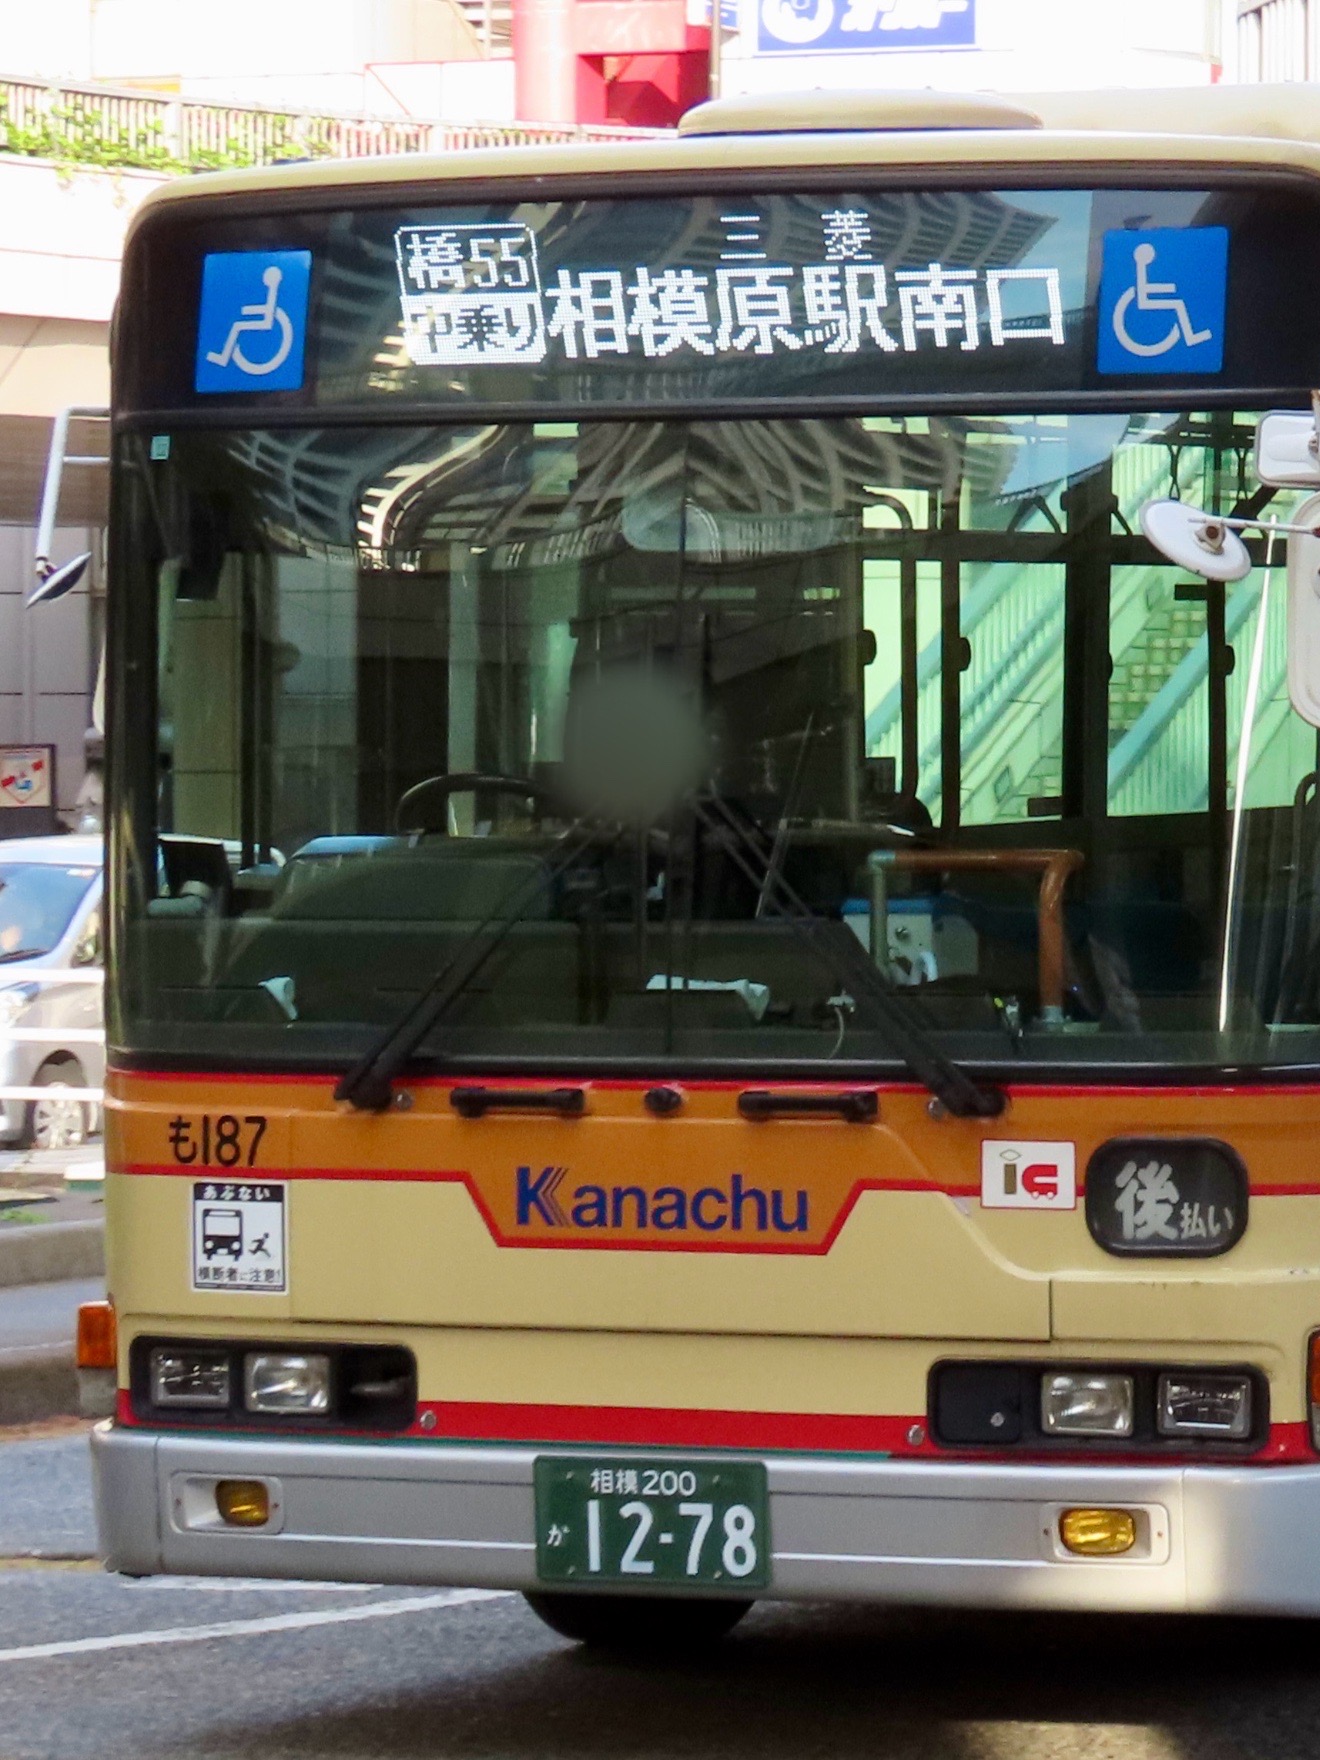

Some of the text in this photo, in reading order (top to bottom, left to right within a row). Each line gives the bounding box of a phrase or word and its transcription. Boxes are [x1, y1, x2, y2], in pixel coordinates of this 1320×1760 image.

[545, 262, 1065, 358] 相模原駅南口
[515, 1166, 809, 1233] Kanachu
[1114, 1160, 1235, 1241] 後払い
